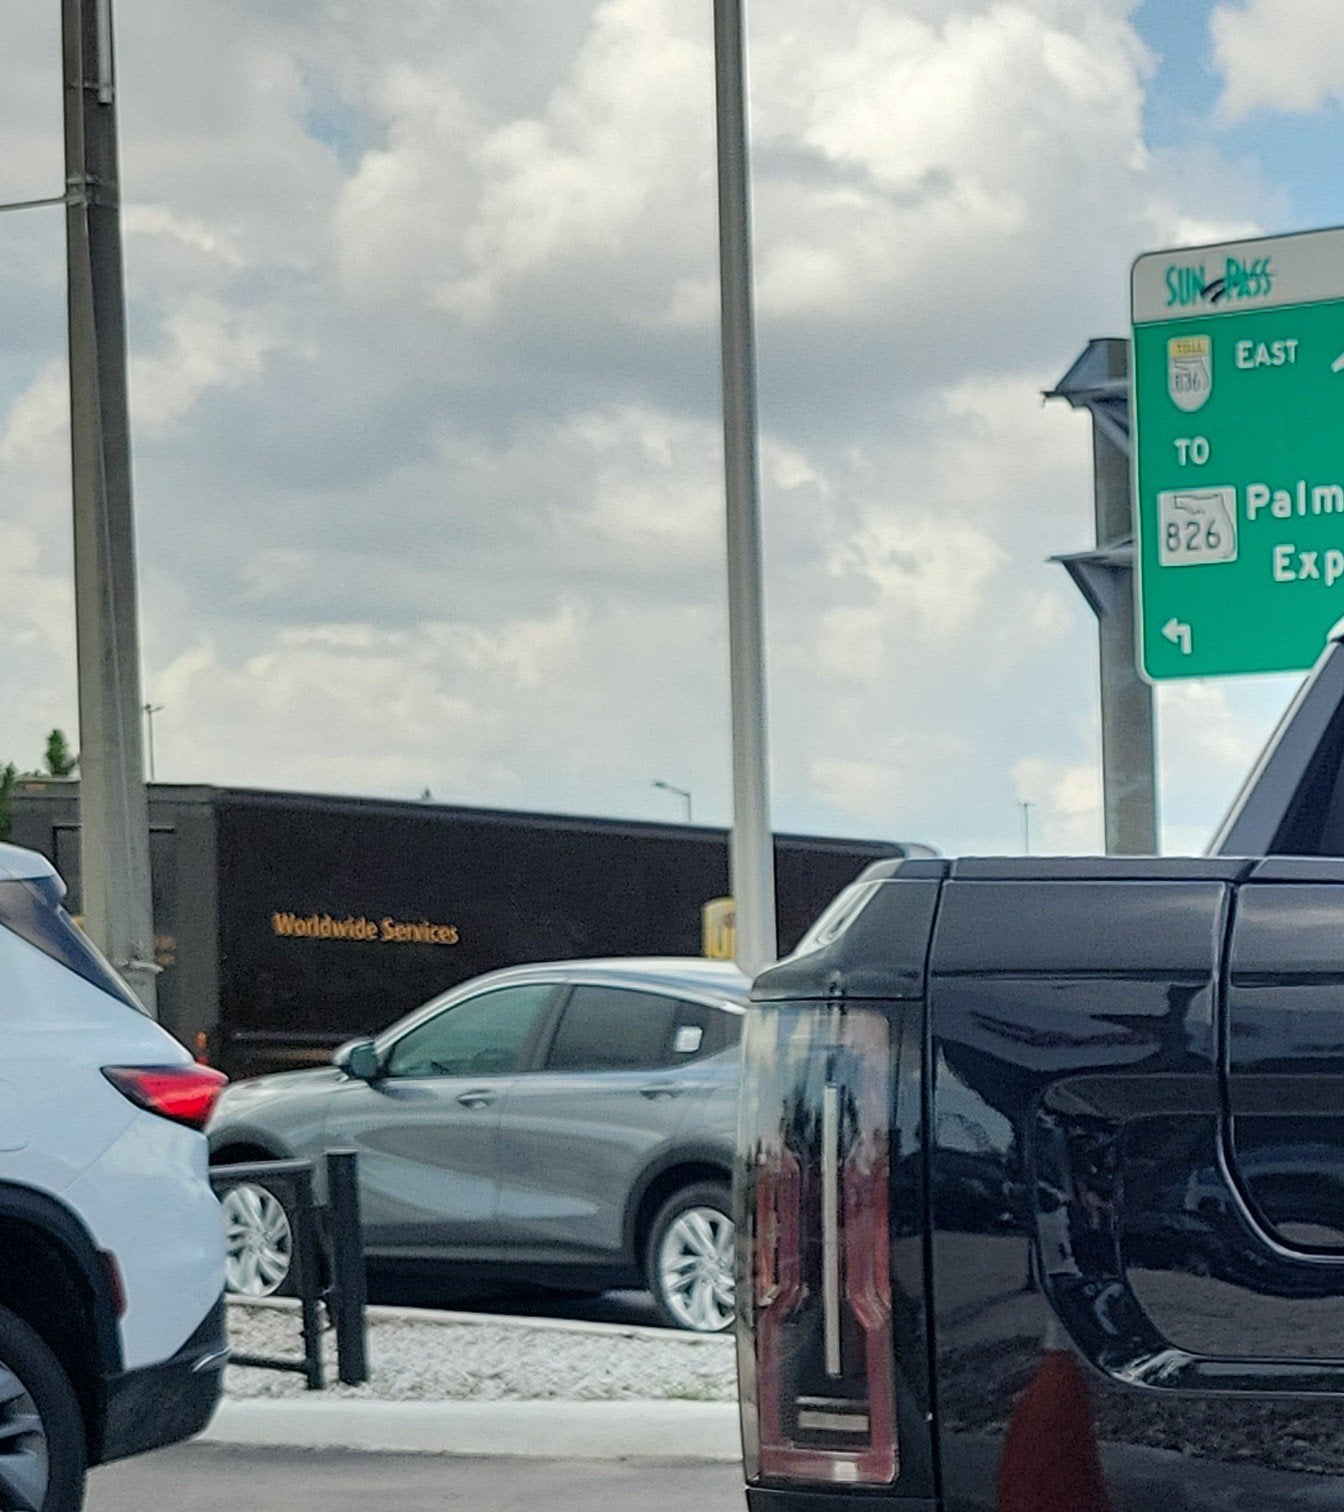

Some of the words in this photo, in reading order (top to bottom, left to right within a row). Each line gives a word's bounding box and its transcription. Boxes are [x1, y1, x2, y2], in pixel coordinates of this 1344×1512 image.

[1235, 339, 1299, 370] EAST
[1174, 436, 1210, 466] TO
[1165, 520, 1222, 552] 826
[271, 911, 379, 940] Worldwide
[380, 916, 459, 944] Services
